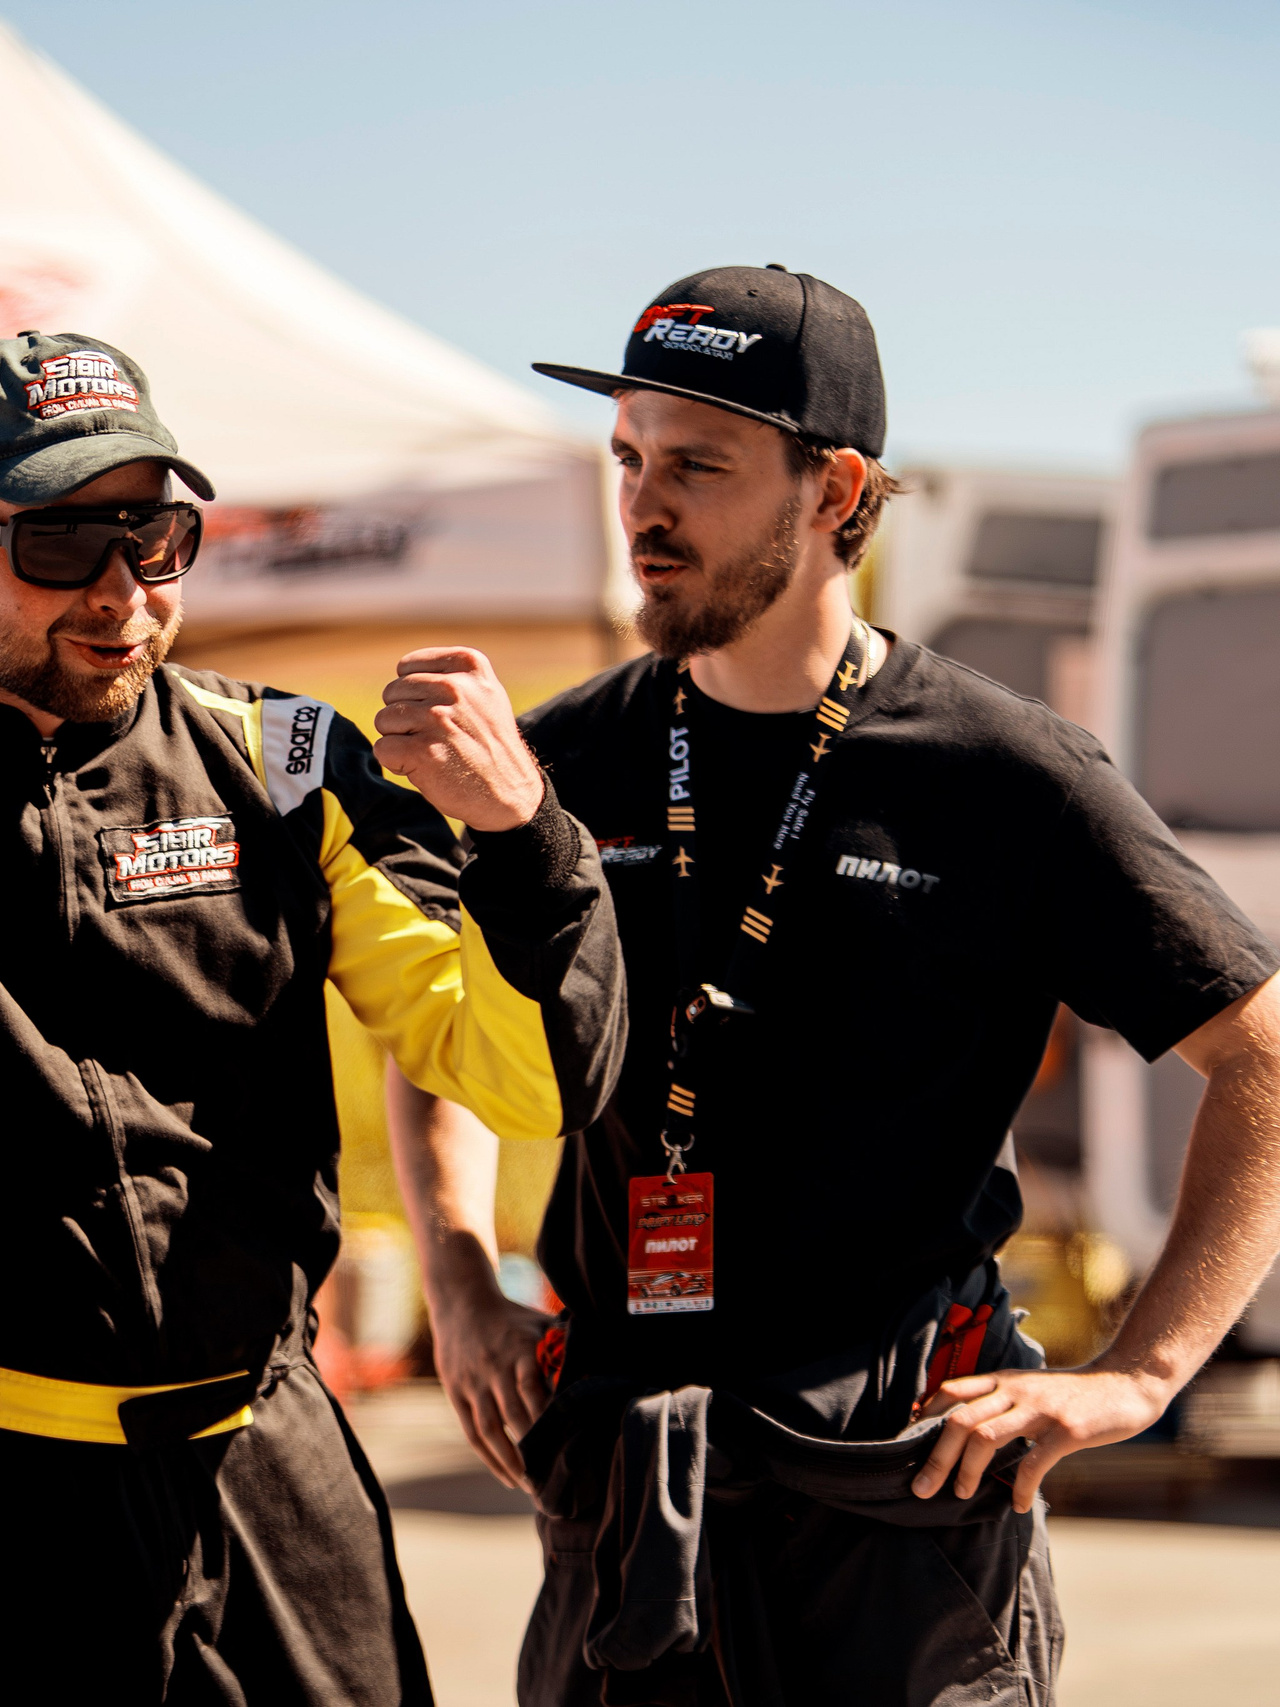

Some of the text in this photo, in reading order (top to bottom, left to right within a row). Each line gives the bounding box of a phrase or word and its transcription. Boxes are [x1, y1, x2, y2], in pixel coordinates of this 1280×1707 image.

[643, 318, 763, 353] READY
[41, 358, 115, 379] SIBIR
[26, 378, 137, 407] MOTORS
[285, 706, 322, 775] sparco
[669, 726, 691, 801] PILOT
[133, 828, 212, 852] SIBIR
[117, 845, 236, 877] MOTORS
[835, 854, 940, 894] ПИЛОТ
[641, 1194, 704, 1207] STRKER
[645, 1238, 698, 1254] ПИЛОТ
